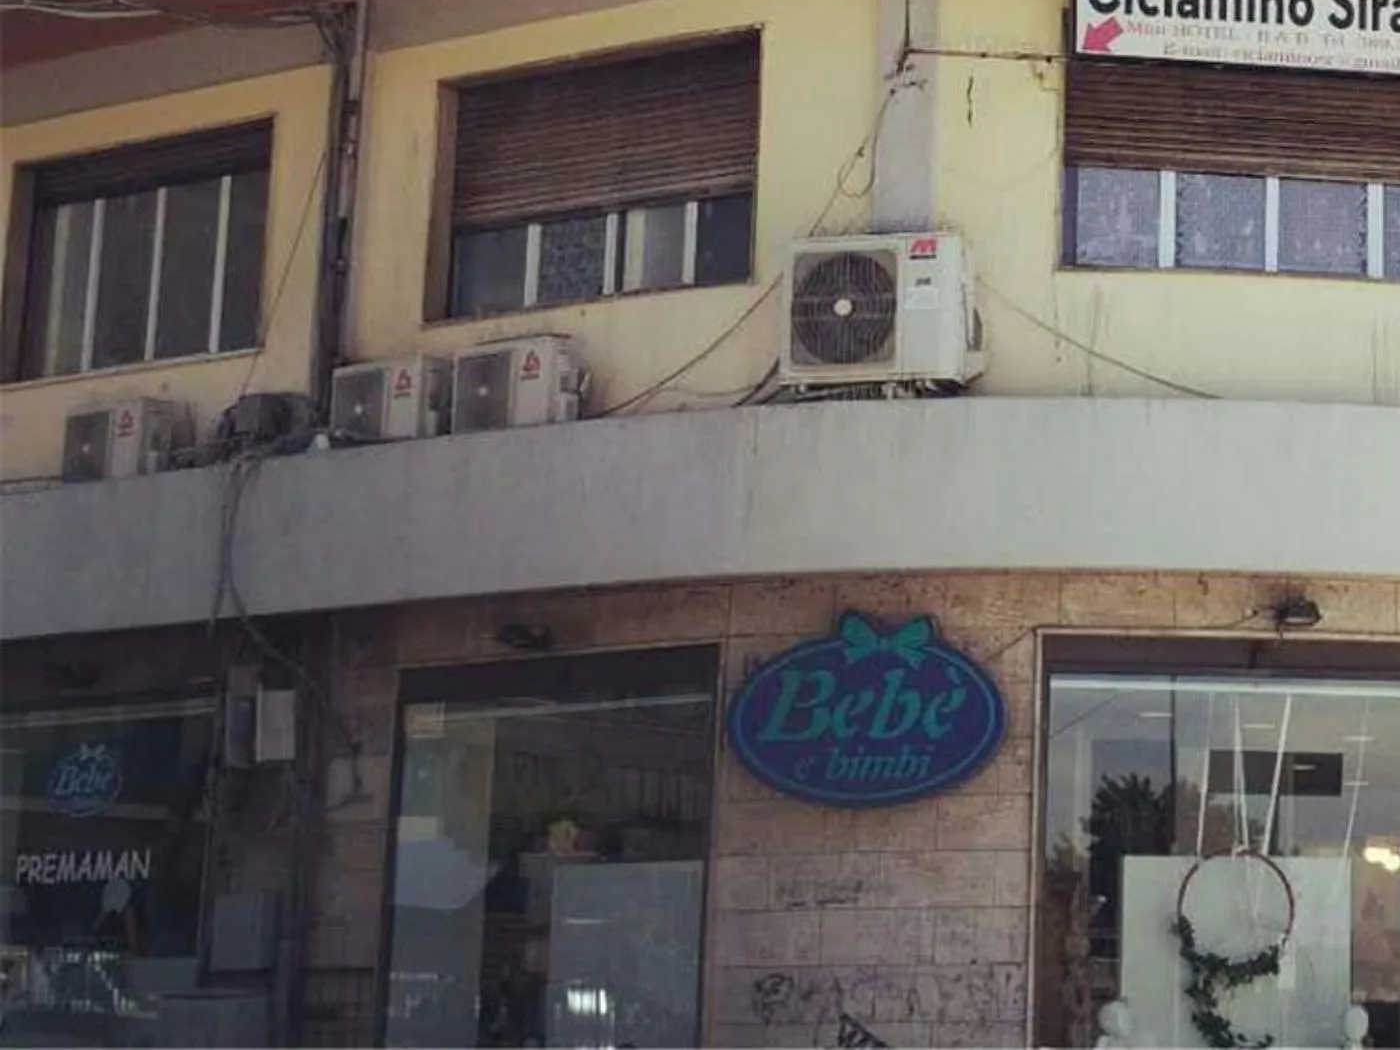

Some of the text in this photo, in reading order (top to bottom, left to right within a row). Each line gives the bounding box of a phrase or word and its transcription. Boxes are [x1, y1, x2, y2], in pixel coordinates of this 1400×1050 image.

[756, 664, 968, 742] Bebè
[825, 744, 935, 783] bimbi
[15, 846, 151, 886] PREMAMAN
